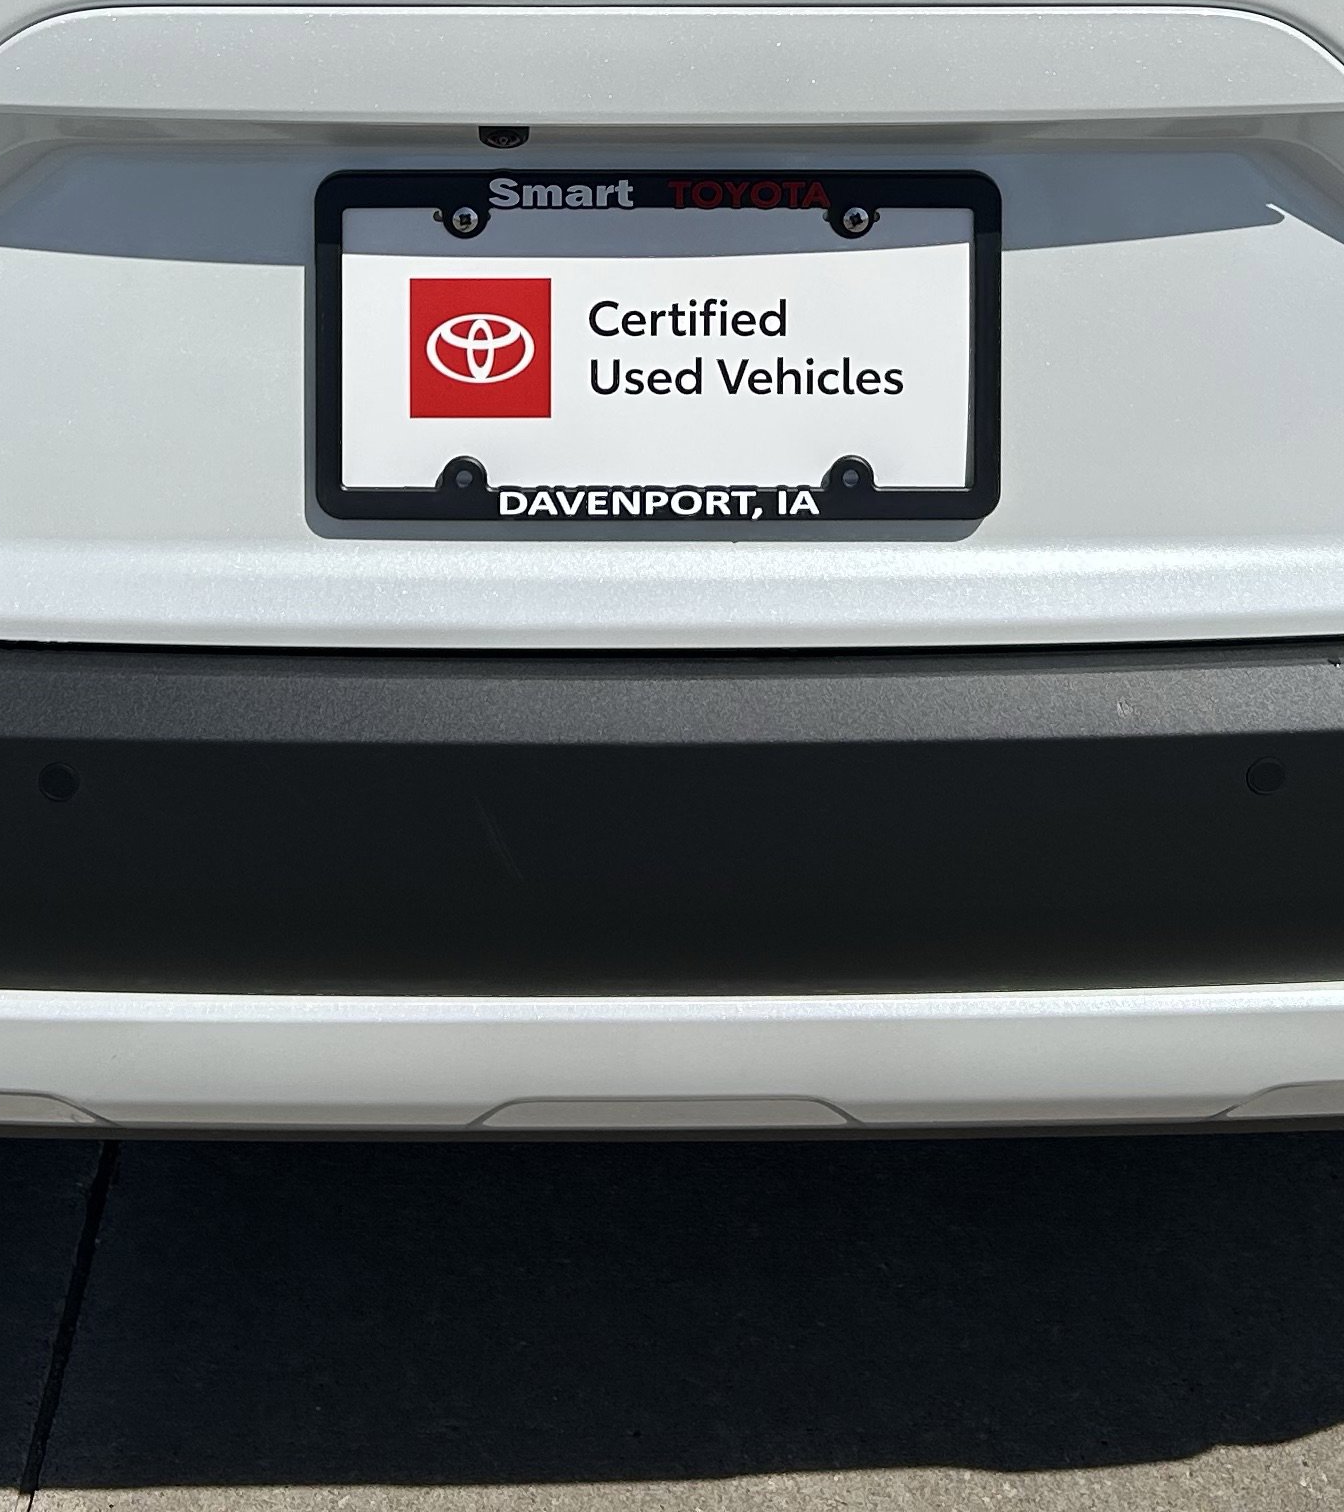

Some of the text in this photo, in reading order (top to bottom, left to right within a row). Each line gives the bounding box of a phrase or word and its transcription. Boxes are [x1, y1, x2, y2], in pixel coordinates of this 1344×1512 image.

[488, 177, 831, 209] Smart TOYOTA
[588, 298, 788, 338] Certified
[590, 356, 905, 396] Used Vehicles
[498, 490, 821, 521] DAVENPORT, IA
